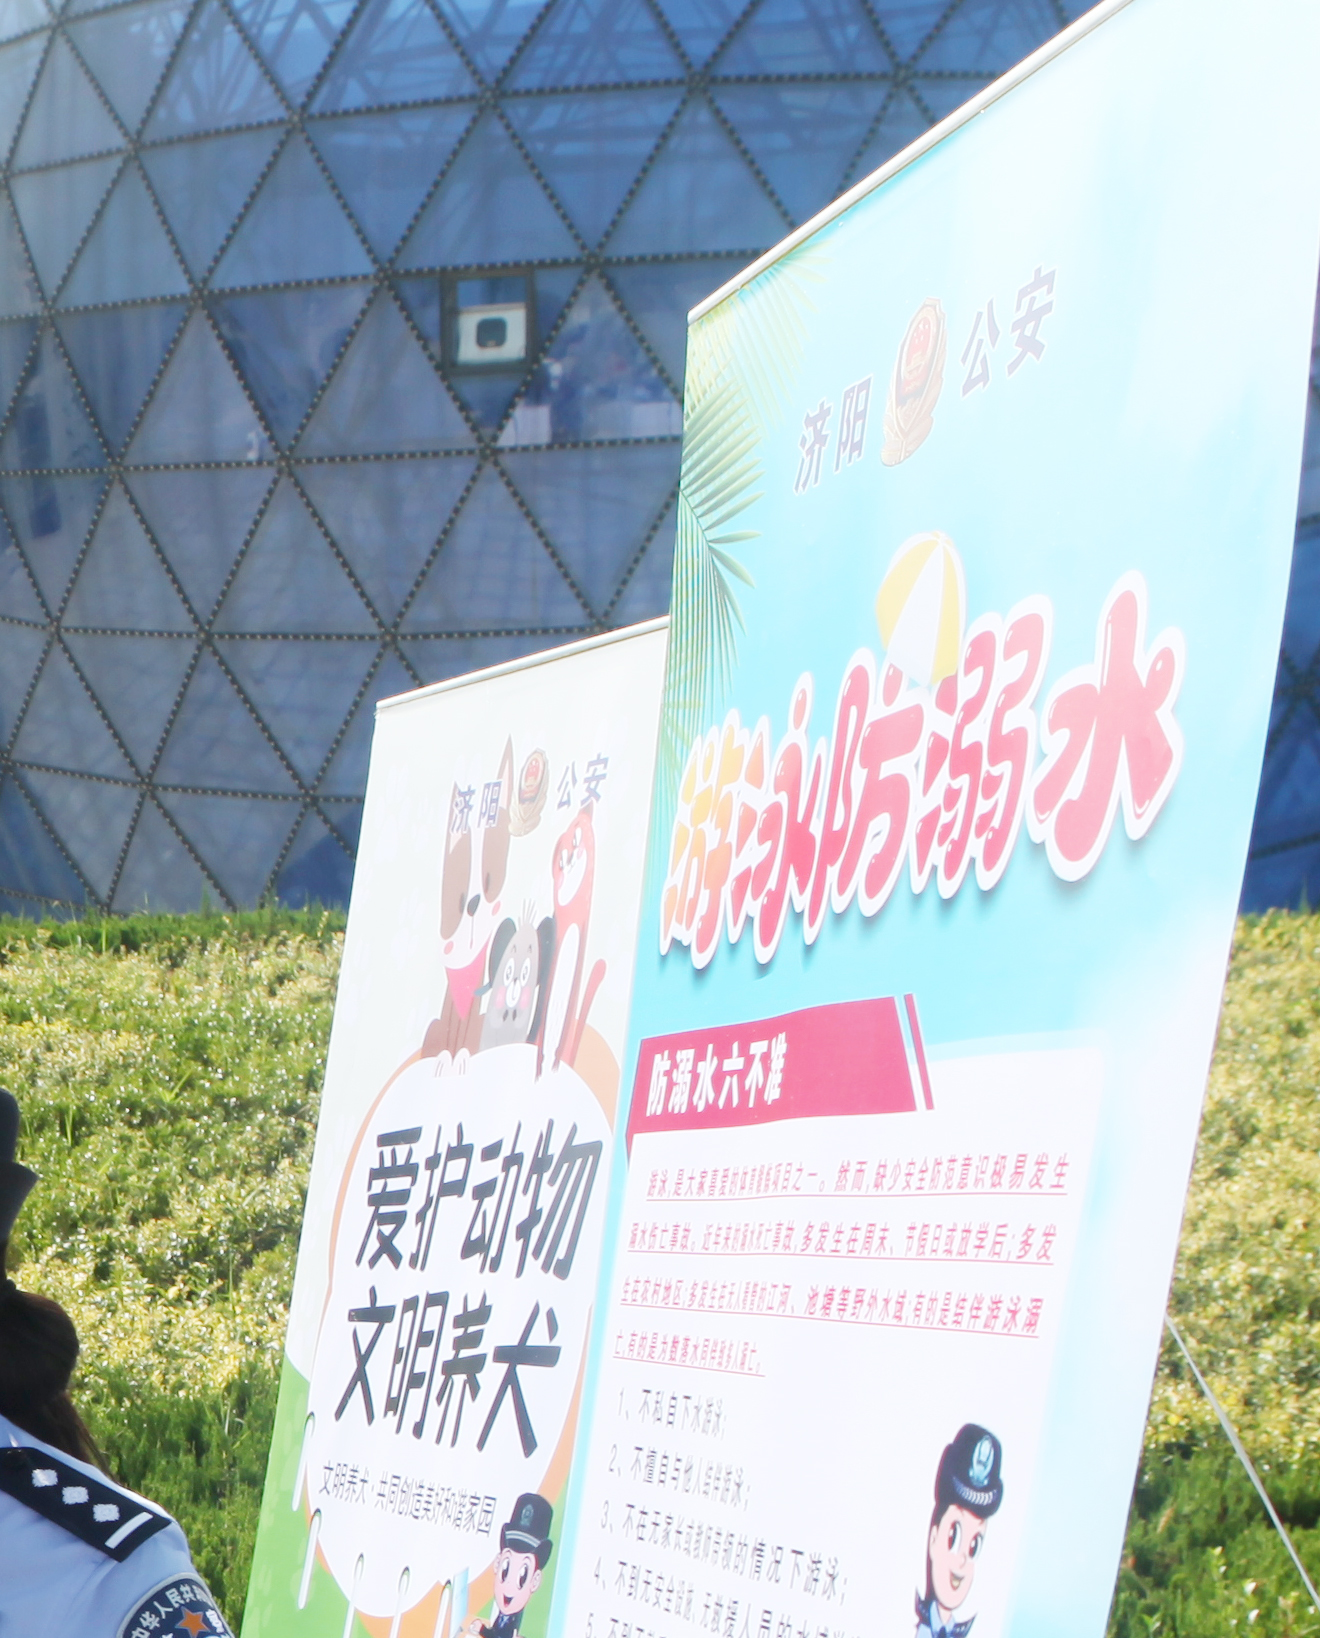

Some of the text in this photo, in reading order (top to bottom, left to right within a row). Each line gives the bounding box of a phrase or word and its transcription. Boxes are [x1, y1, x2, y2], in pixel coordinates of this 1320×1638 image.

[793, 264, 1057, 495] 济阳 公安
[451, 752, 609, 833] 济阳 公安
[661, 580, 1180, 964] 游泳防溺水
[645, 1033, 788, 1118] 防溺水六不准
[355, 1118, 603, 1281] 爱护动物
[334, 1285, 562, 1459] 文明养犬
